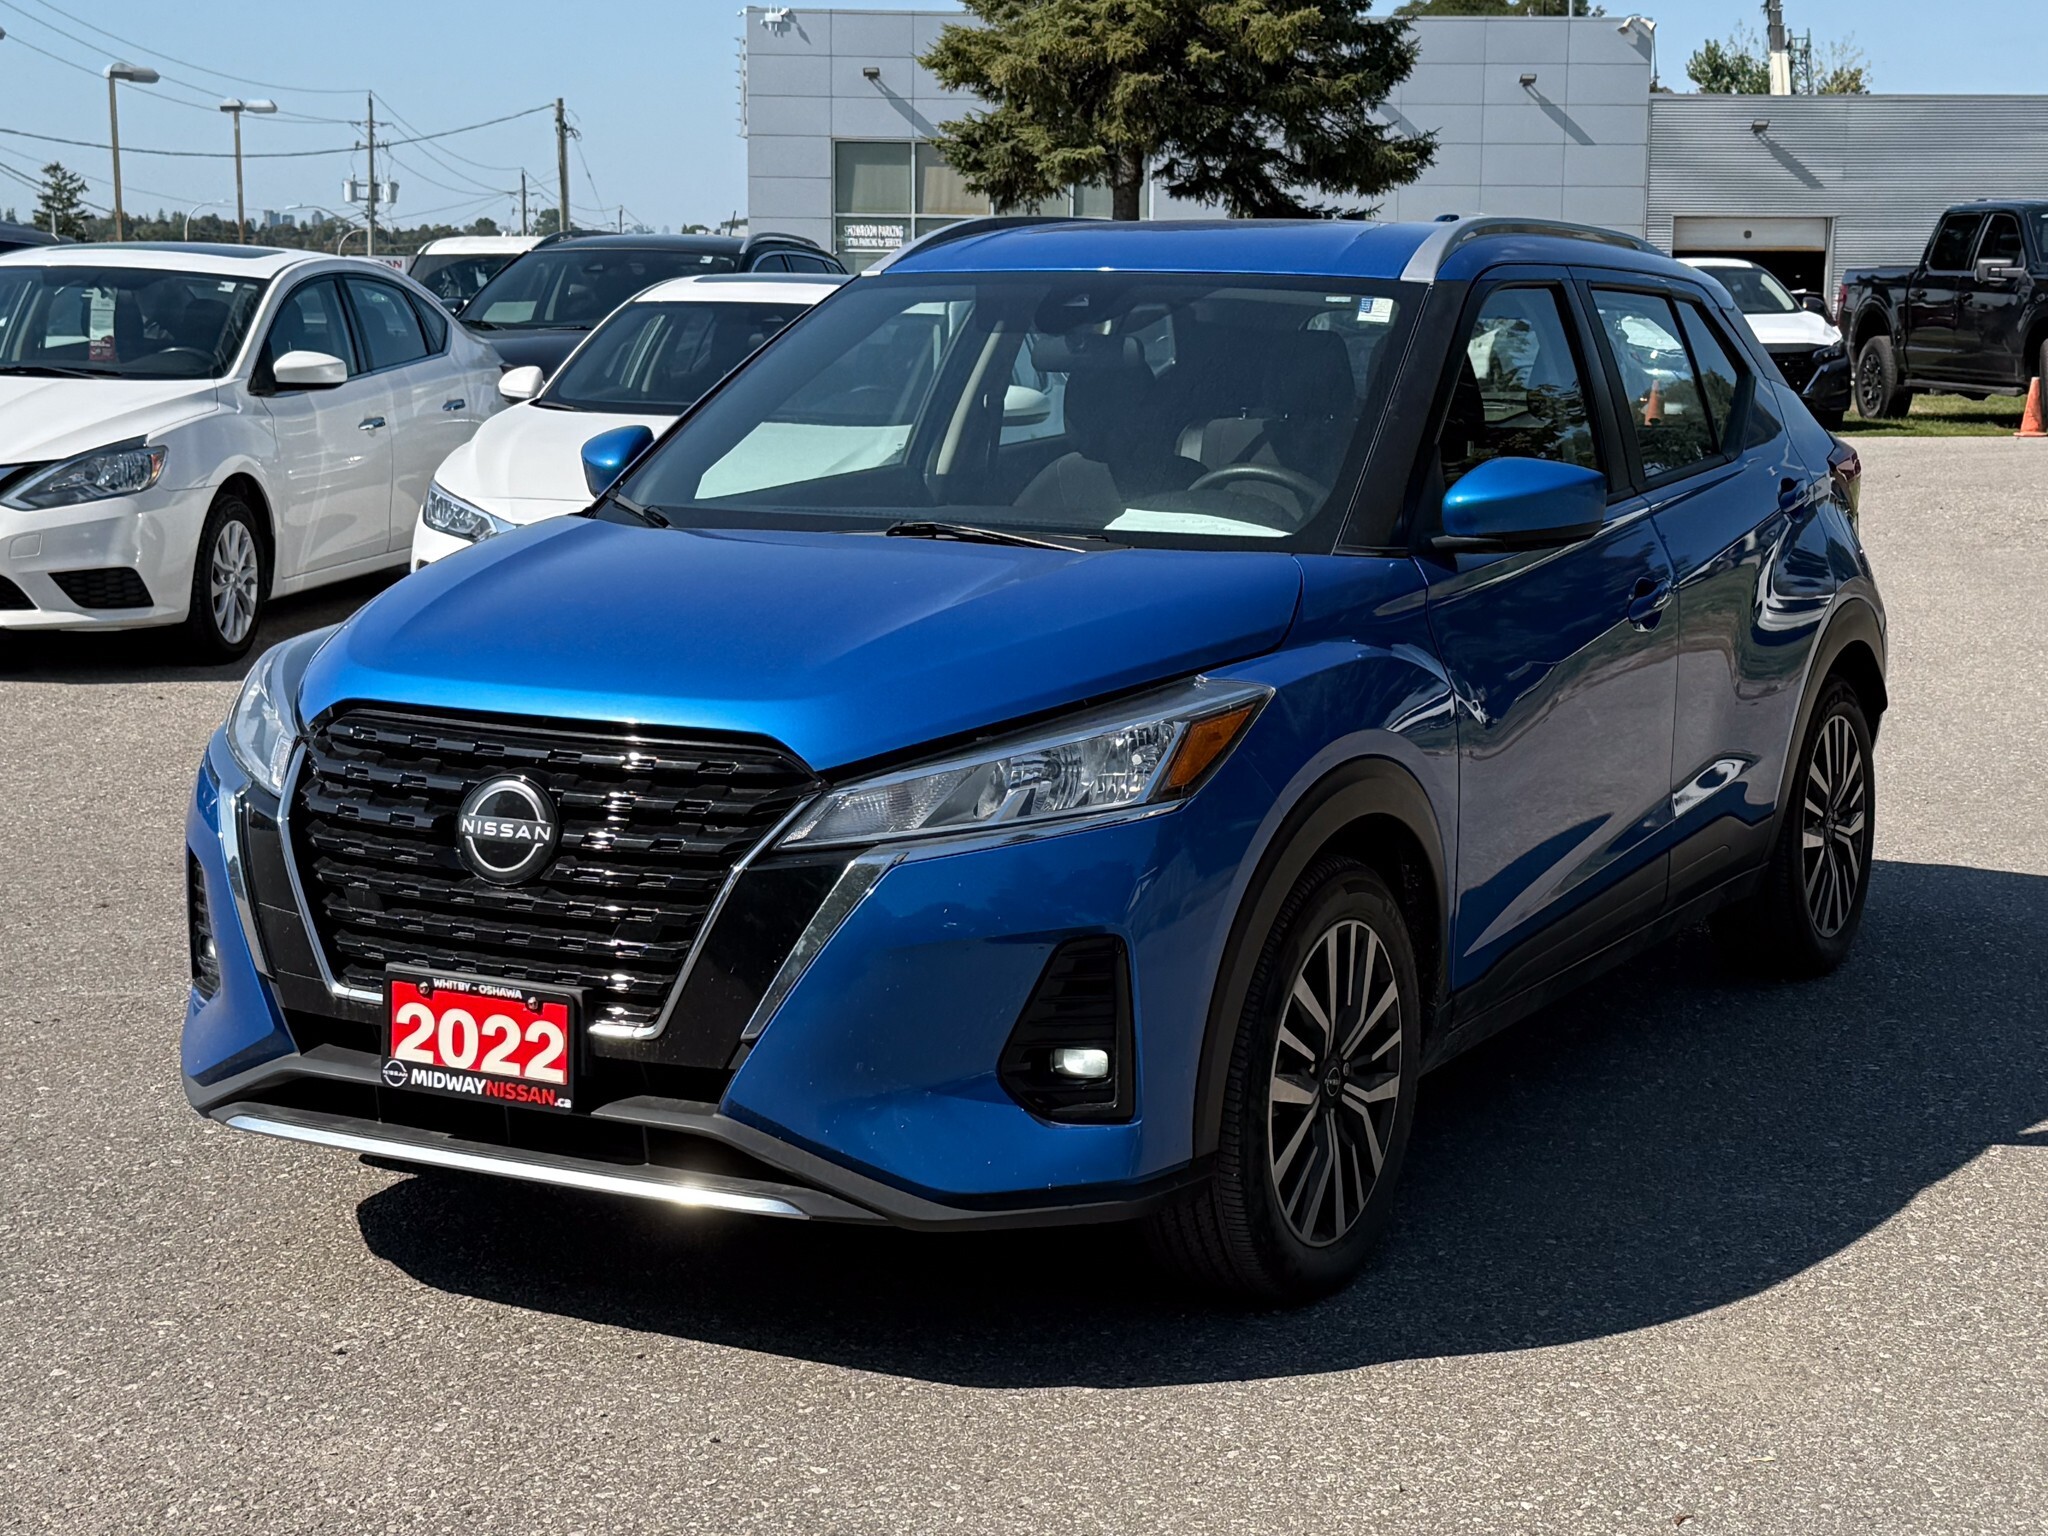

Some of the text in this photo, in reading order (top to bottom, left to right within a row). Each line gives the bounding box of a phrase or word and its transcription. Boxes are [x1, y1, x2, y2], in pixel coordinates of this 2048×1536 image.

[878, 225, 904, 238] PARKING
[462, 818, 551, 841] NISSAN
[433, 978, 471, 992] WHITBY
[478, 985, 523, 1000] OSHAWA
[395, 1002, 565, 1083] 2022
